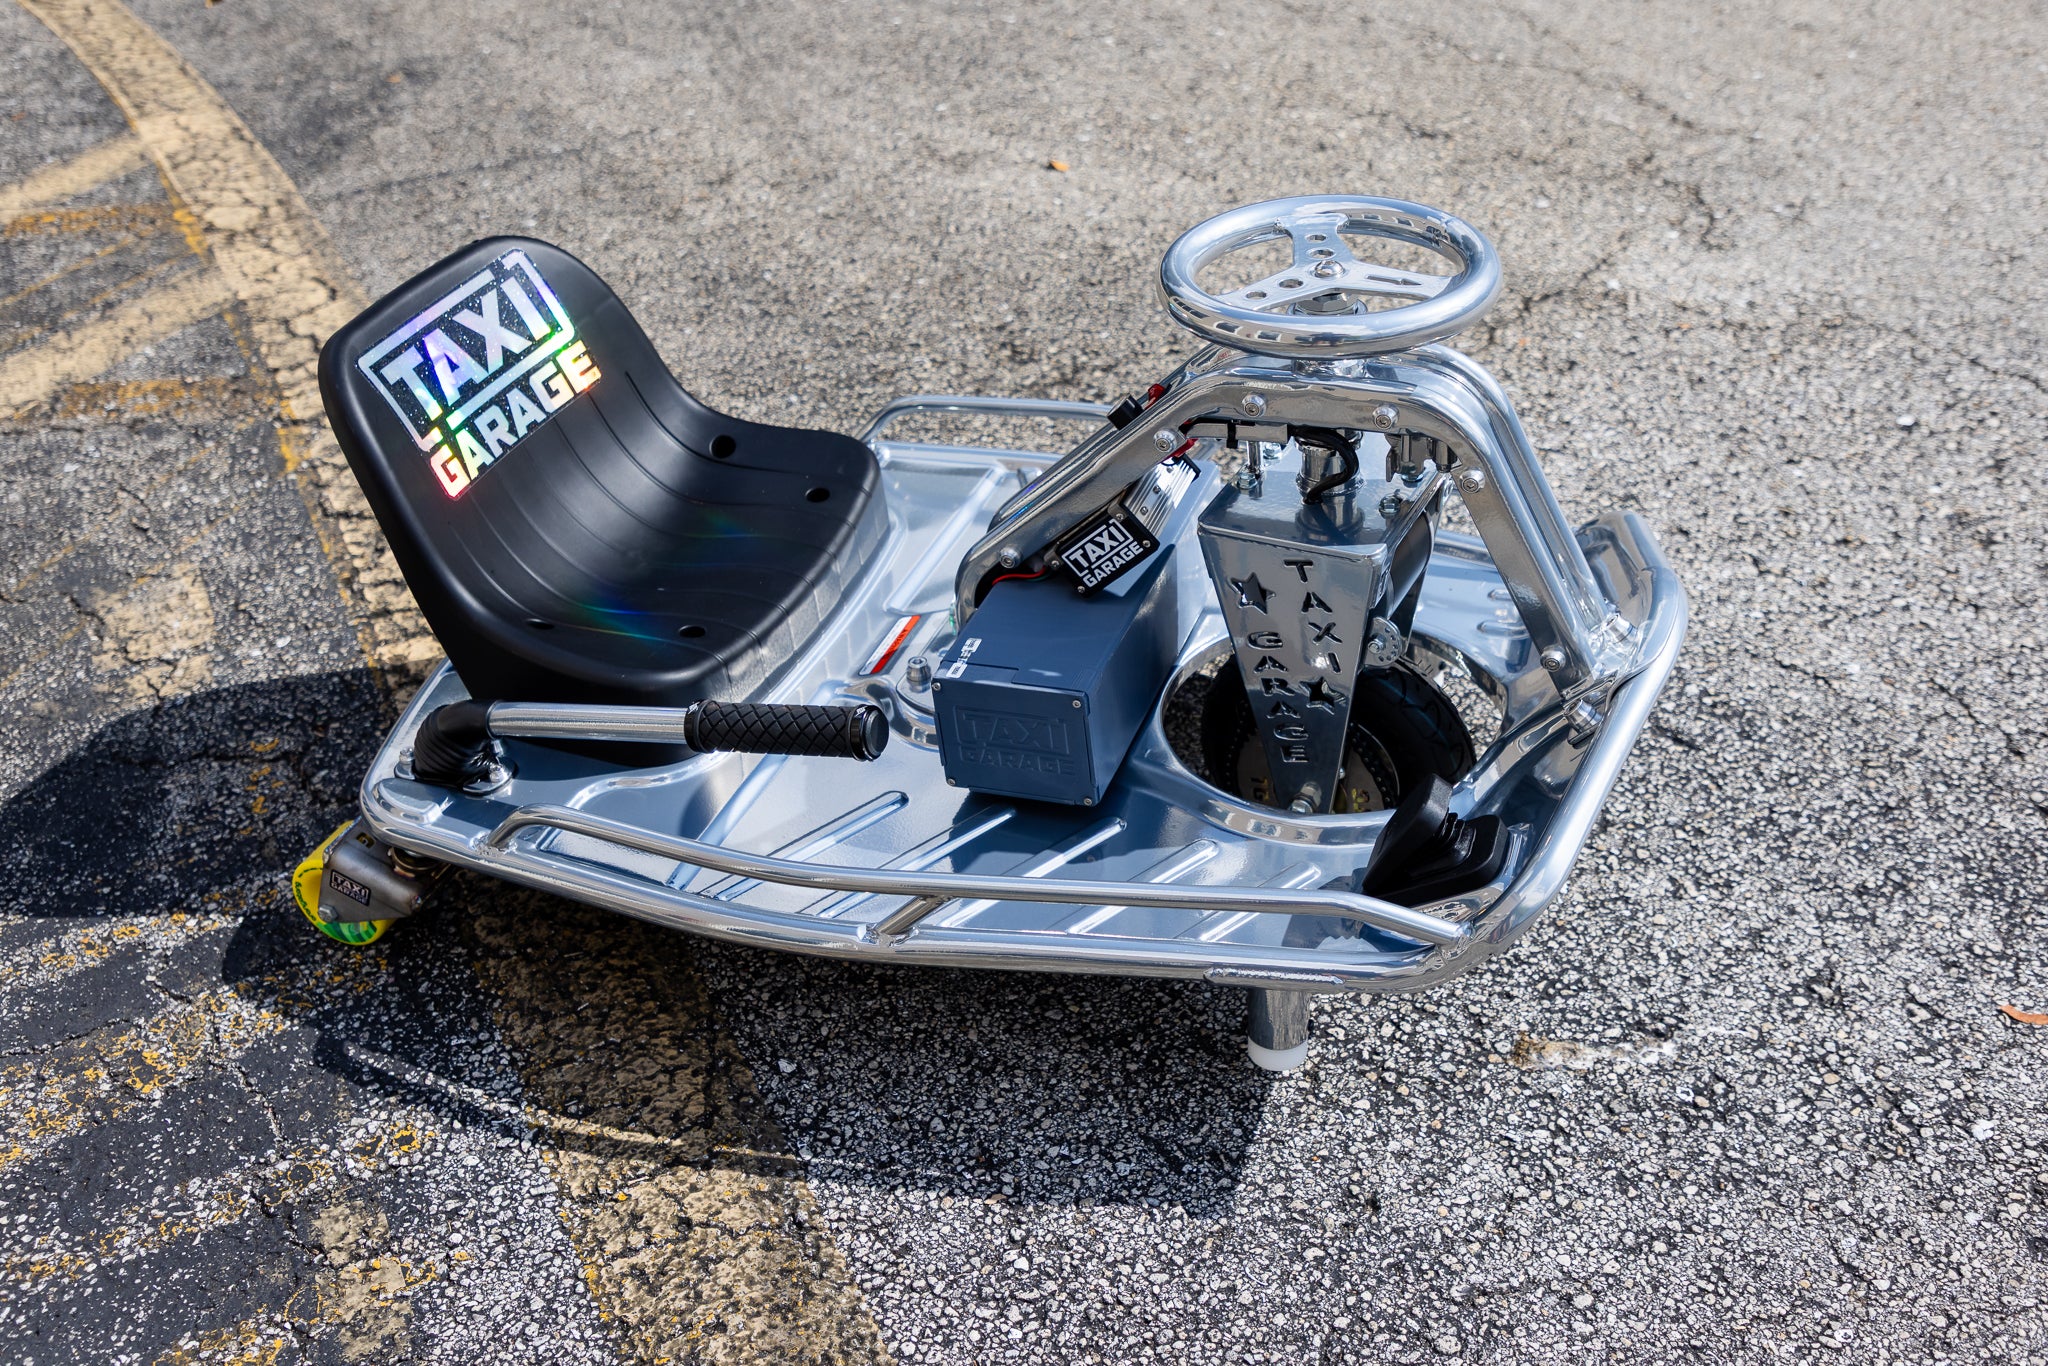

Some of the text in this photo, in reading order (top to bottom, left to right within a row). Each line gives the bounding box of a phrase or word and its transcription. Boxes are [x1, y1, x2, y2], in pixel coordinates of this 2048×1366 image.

[380, 277, 551, 421] TAXI
[430, 340, 601, 498] GARAGE
[1069, 525, 1125, 568] TAXI
[1083, 541, 1144, 587] GARAGE
[1284, 559, 1342, 673] TAXI
[1247, 631, 1309, 763] GARAGE
[963, 712, 1058, 750] TAXI
[960, 747, 1075, 775] GARAGE
[336, 874, 366, 897] TAXI
